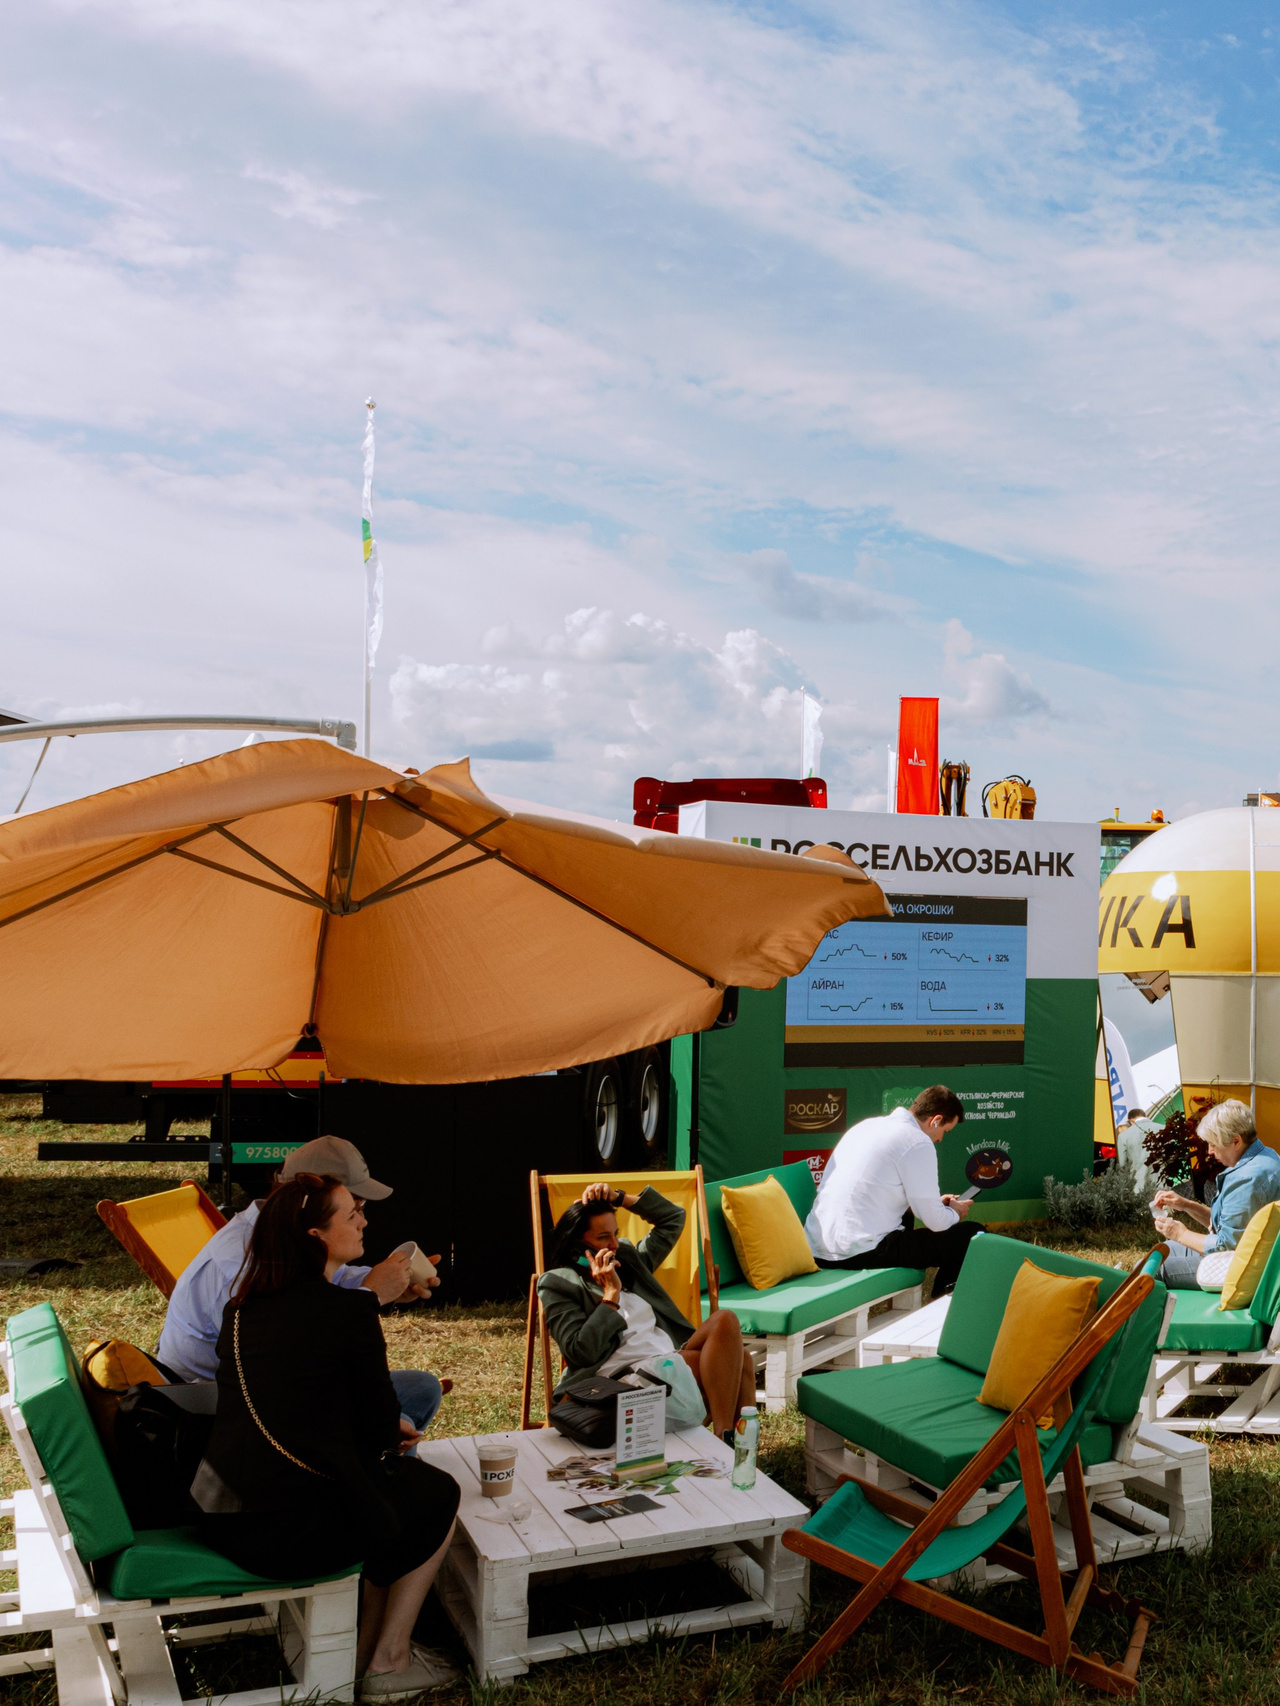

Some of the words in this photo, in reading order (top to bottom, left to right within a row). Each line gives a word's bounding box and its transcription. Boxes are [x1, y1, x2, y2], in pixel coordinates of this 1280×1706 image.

[771, 838, 1075, 877] РСЕЛЬХОЗБАНК
[906, 903, 954, 915] ОКРОШКИ
[921, 931, 954, 942] КЕФИР
[891, 952, 908, 961] 50%
[995, 953, 1010, 963] 32%
[811, 978, 845, 990] АЙРАН
[920, 981, 947, 992] ВОДА
[890, 1002, 904, 1011] 15%
[993, 1002, 1004, 1011] 3%
[788, 1103, 839, 1115] РОСКАР
[966, 1139, 996, 1155] Mendoza
